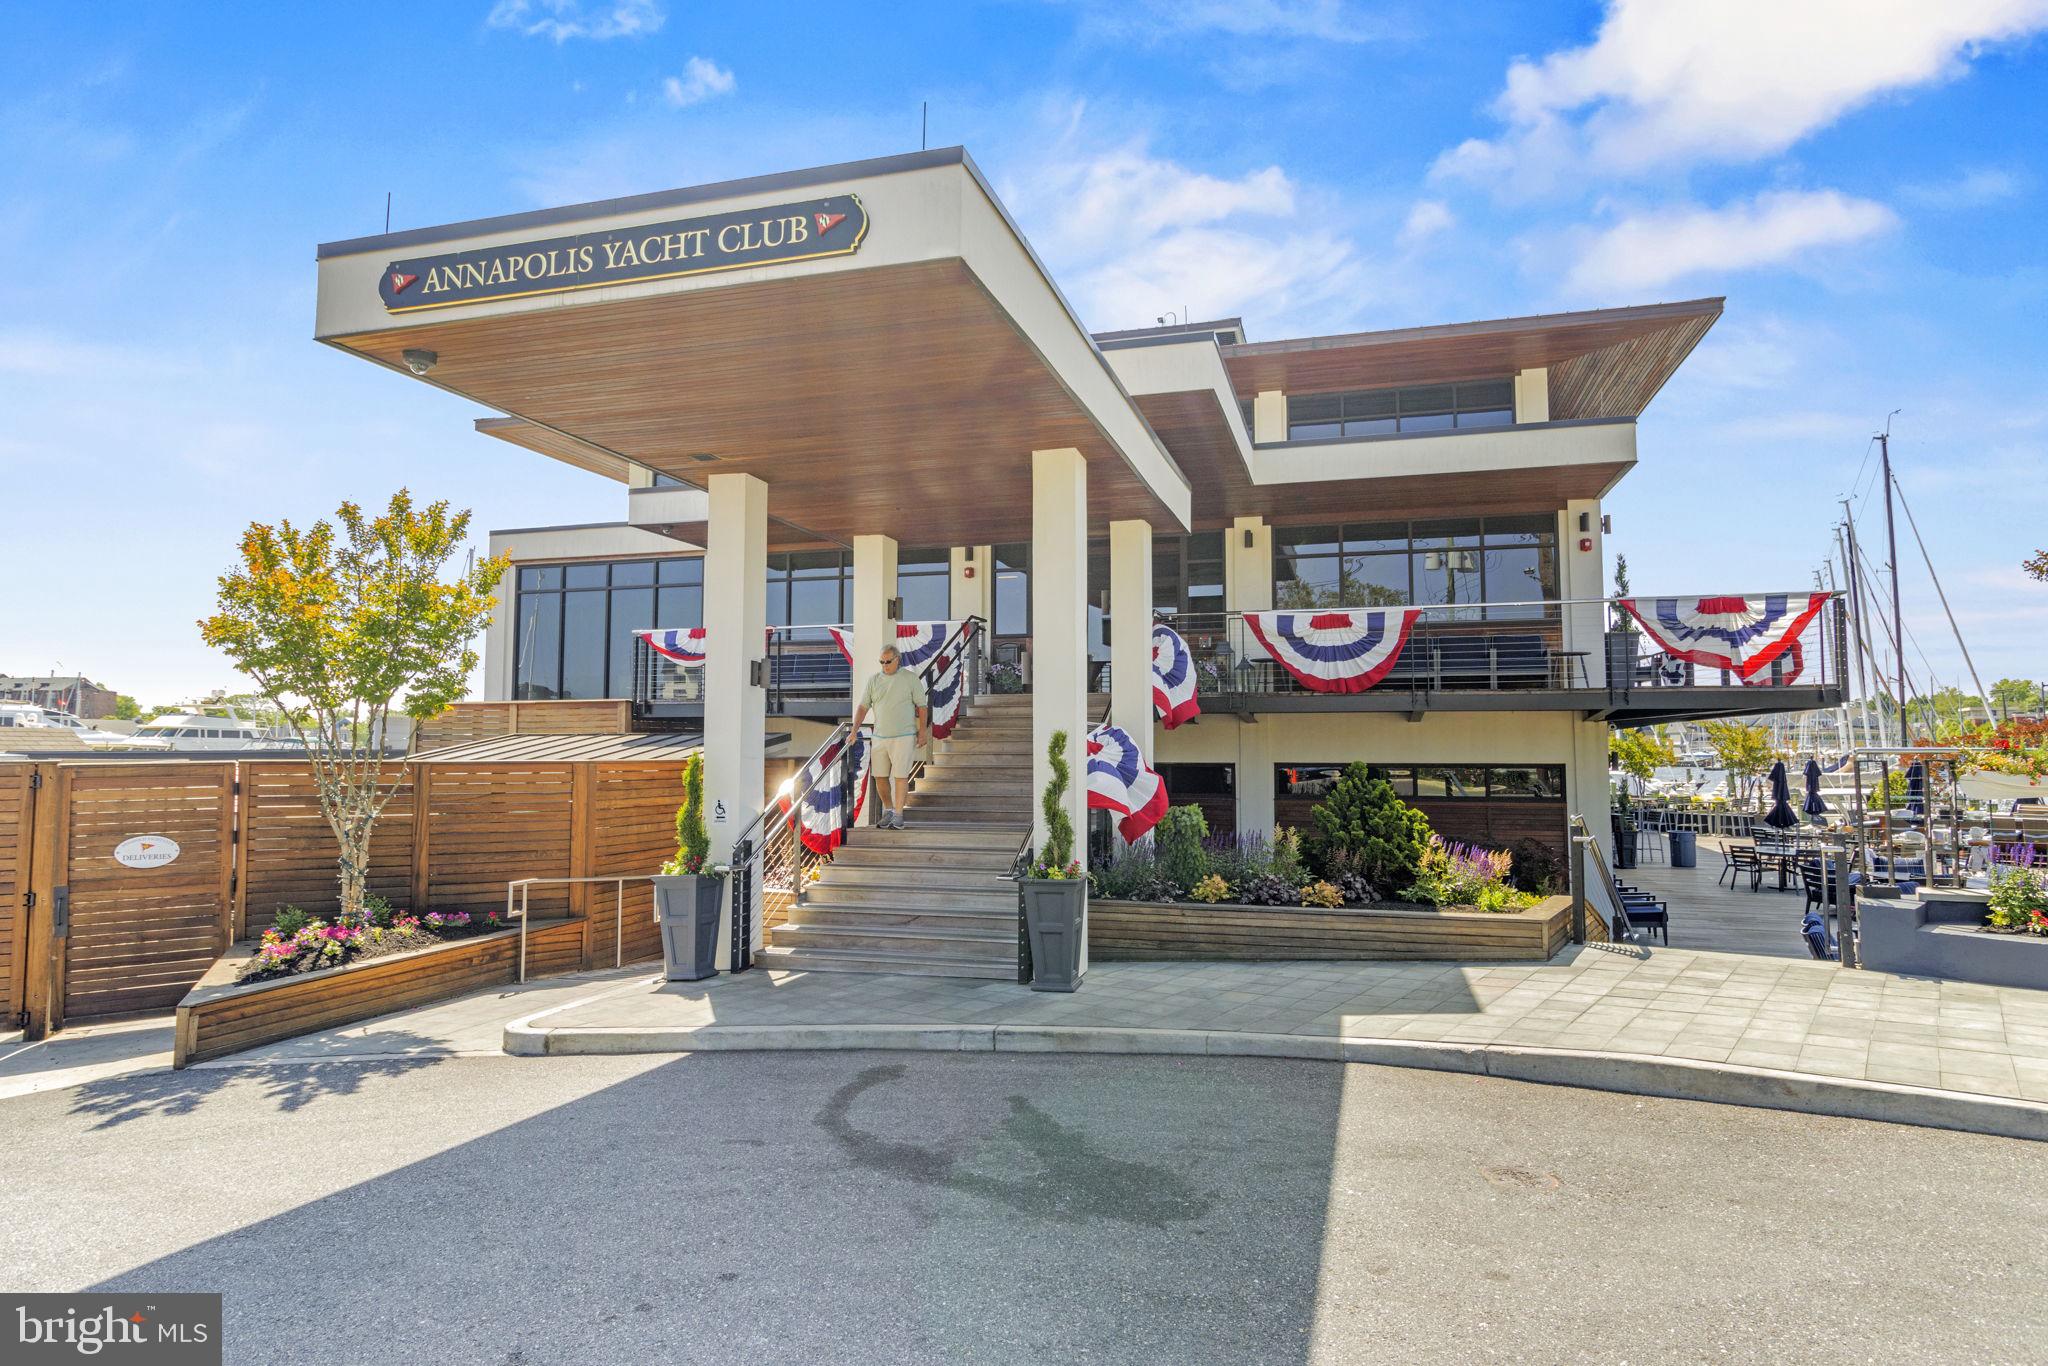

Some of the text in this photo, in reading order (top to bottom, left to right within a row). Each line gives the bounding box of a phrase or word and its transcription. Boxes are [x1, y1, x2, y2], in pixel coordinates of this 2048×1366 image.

[422, 216, 808, 293] ANNAPOLIS YACHT CLUB
[122, 853, 172, 861] DELIVERIES
